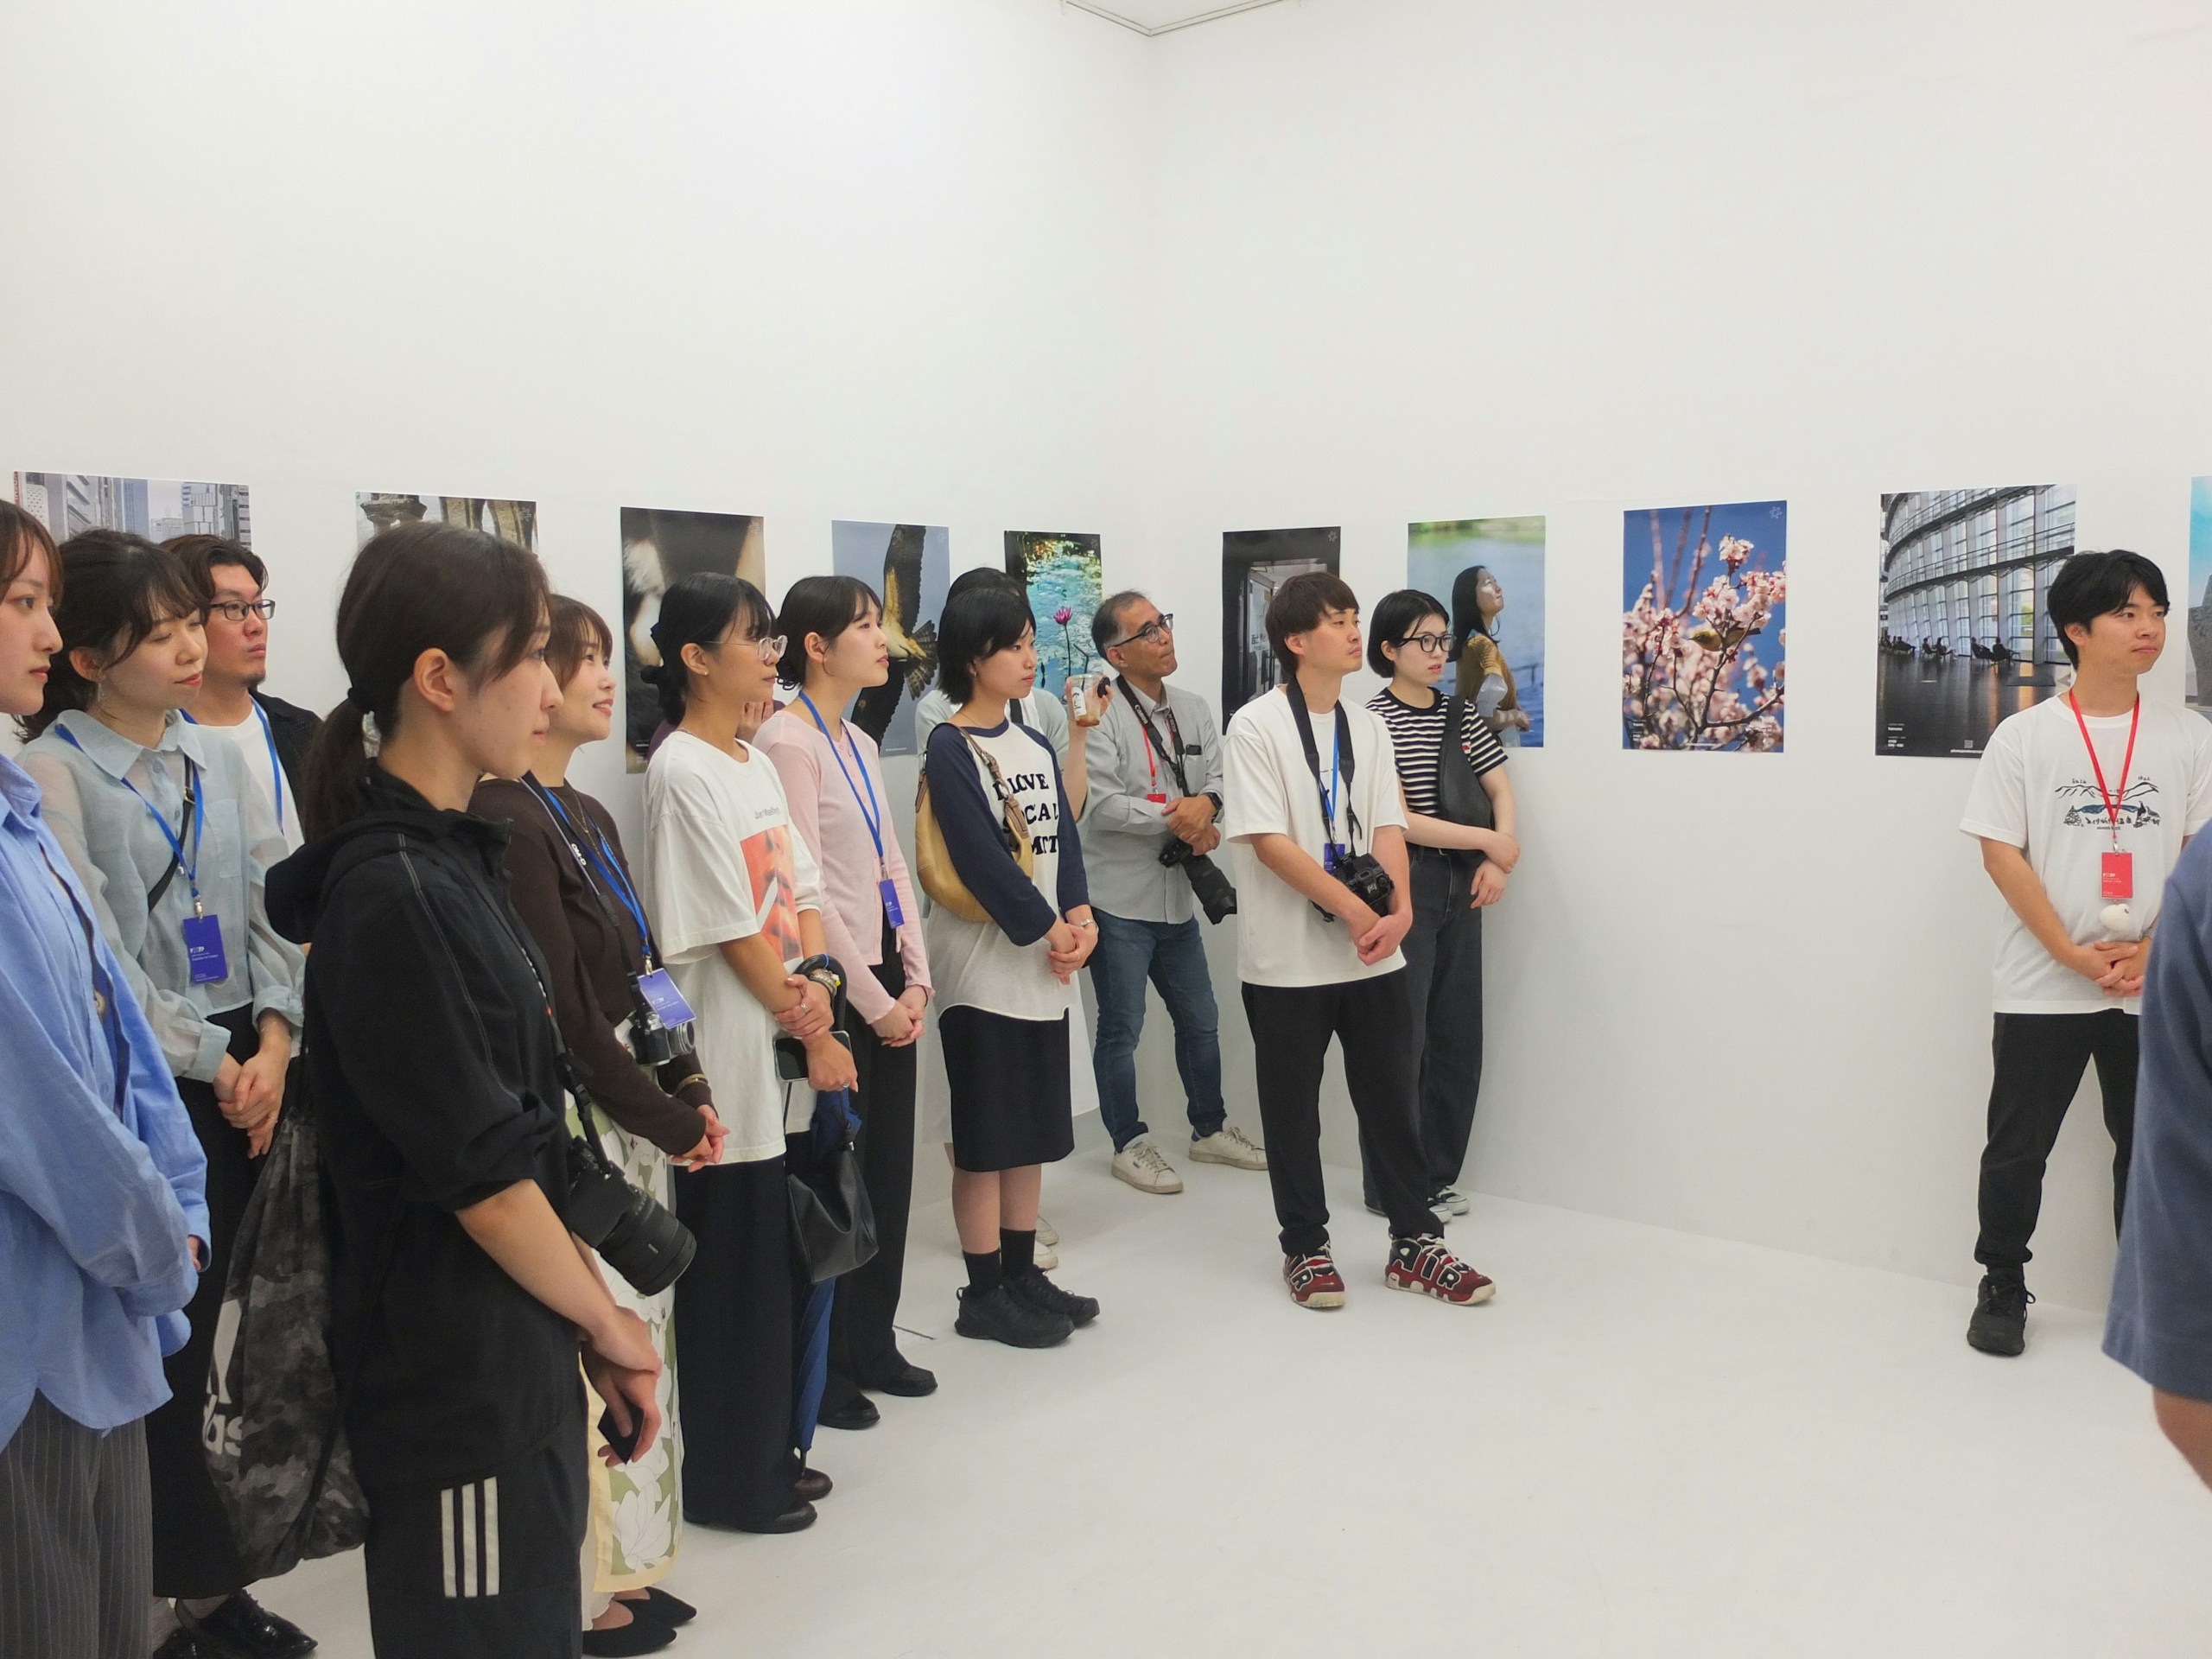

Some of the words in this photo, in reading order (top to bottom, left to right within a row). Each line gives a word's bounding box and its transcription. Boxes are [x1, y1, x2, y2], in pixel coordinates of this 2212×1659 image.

[1135, 704, 1148, 725] Canon
[1007, 773, 1049, 794] LOVE
[571, 842, 587, 866] OM-D
[1389, 1237, 1462, 1291] AIR
